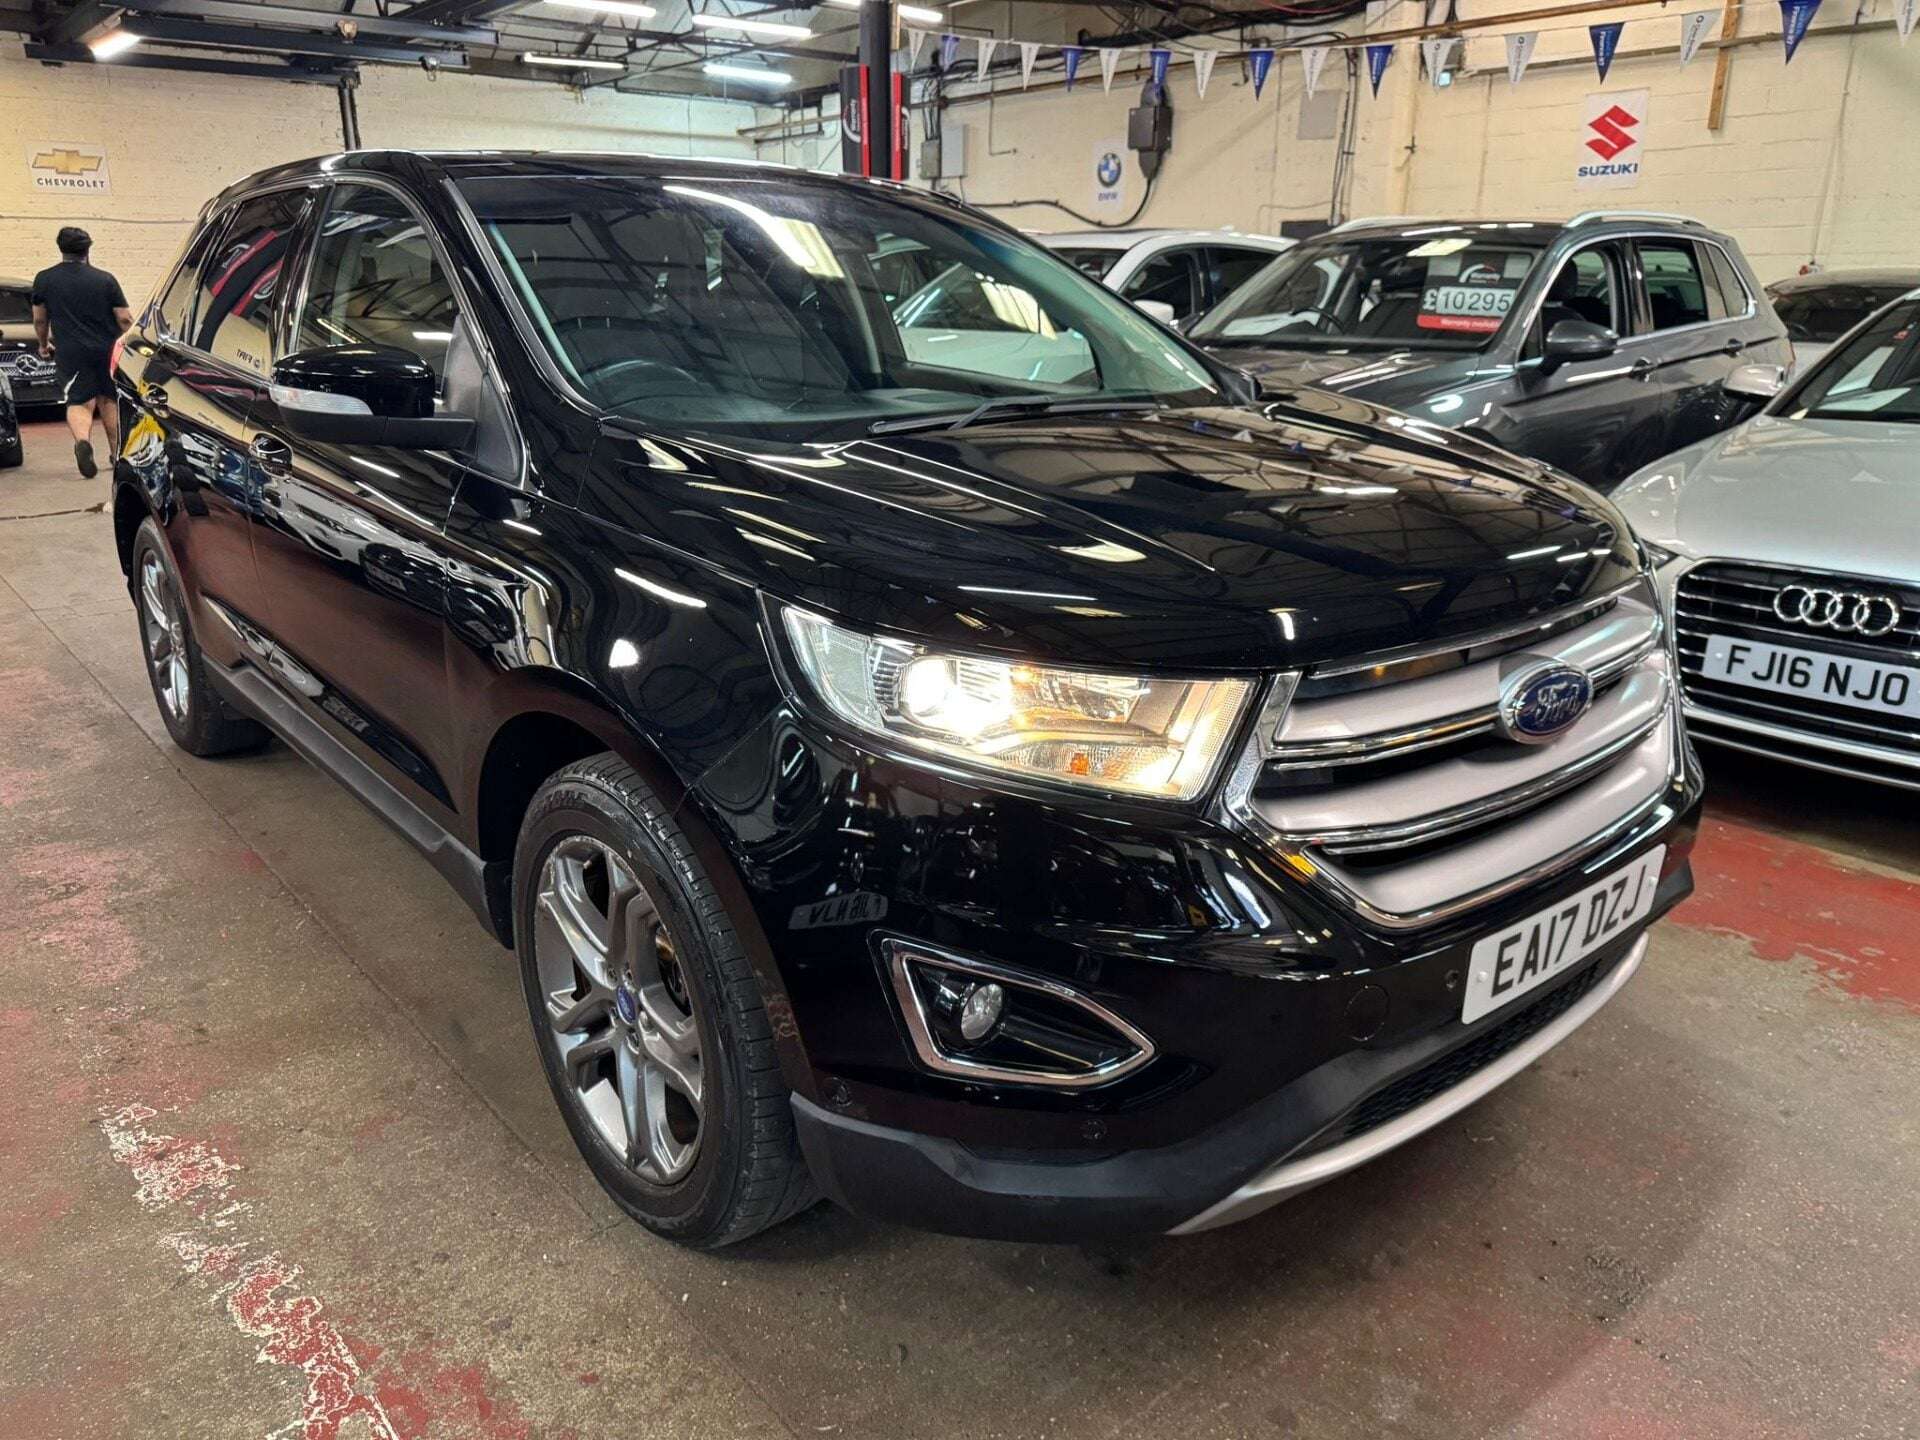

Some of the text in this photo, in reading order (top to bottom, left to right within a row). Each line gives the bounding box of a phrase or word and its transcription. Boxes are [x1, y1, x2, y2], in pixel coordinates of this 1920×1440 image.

[36, 177, 105, 188] CHEVROLET
[1578, 162, 1639, 177] SUZUKI
[1726, 644, 1910, 706] FJ16 NJO
[1535, 682, 1580, 721] Ford
[1491, 864, 1647, 998] EA17 DZJ
